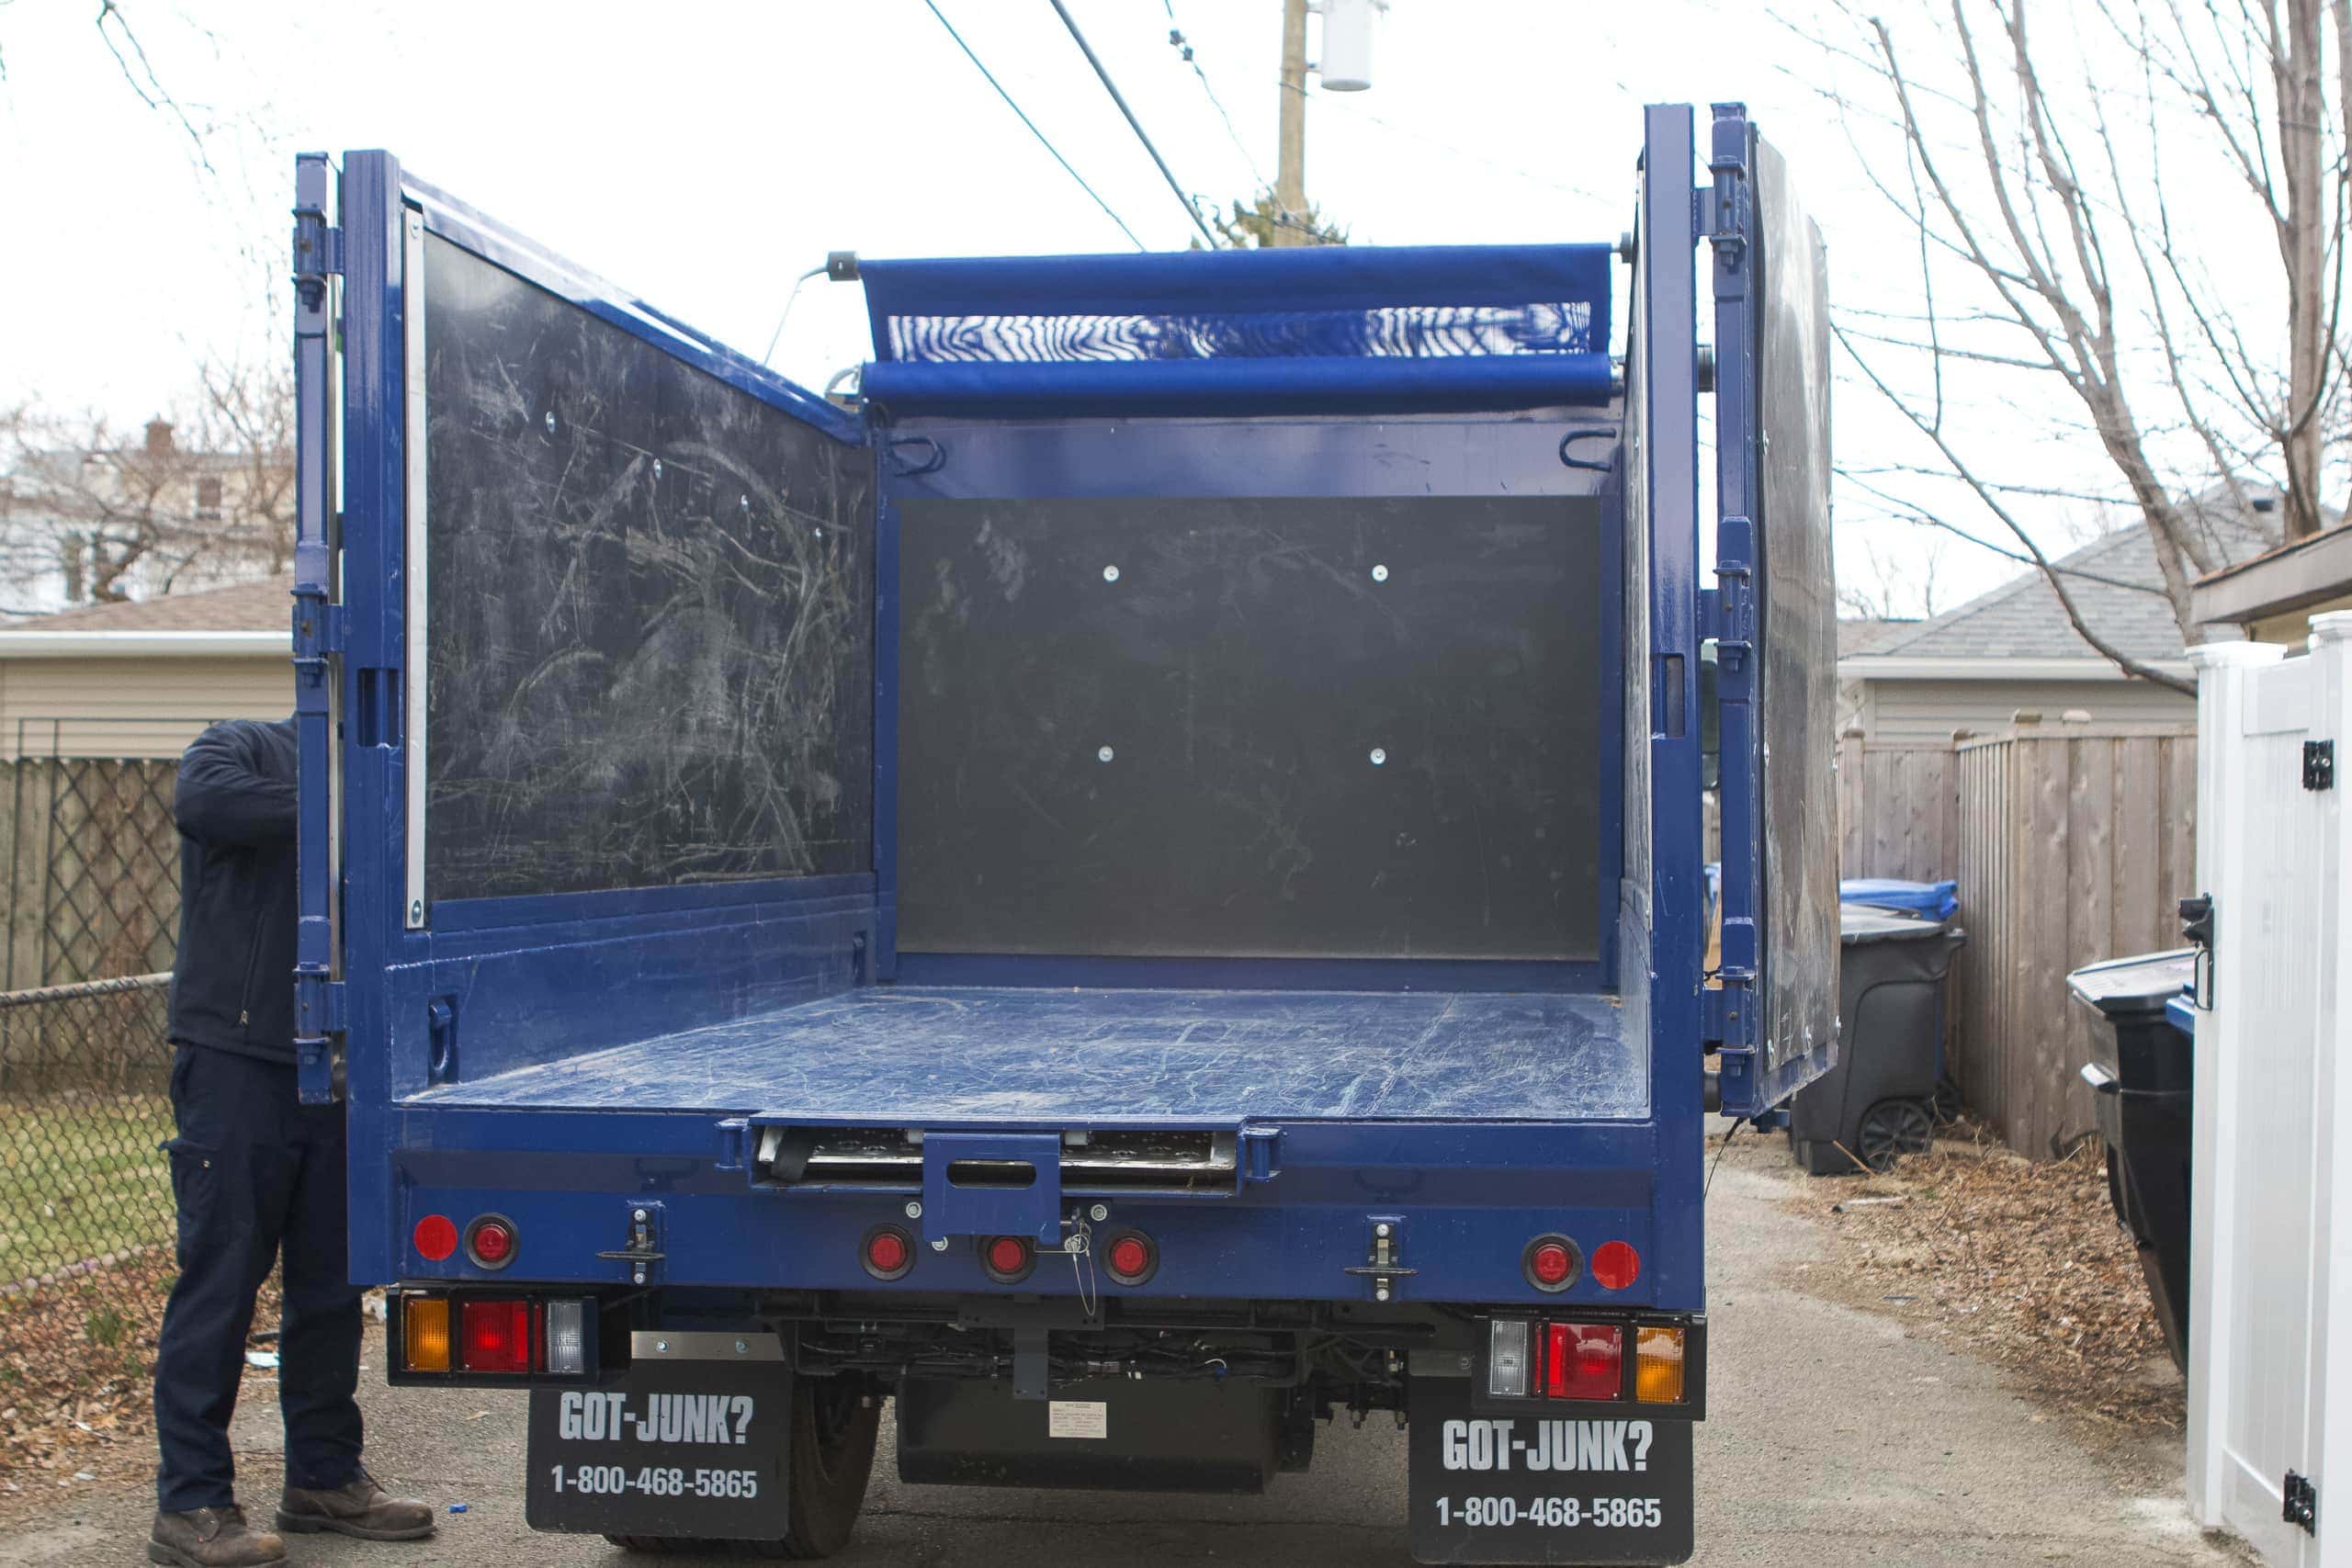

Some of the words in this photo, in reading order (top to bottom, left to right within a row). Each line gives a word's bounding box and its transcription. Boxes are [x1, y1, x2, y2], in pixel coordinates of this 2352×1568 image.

[559, 1391, 753, 1444] GOT-JUNK?
[1442, 1419, 1654, 1472] GOT-JUNK?
[551, 1464, 757, 1499] 1-800-468-5865
[1436, 1496, 1662, 1529] 1-800-468-5865
